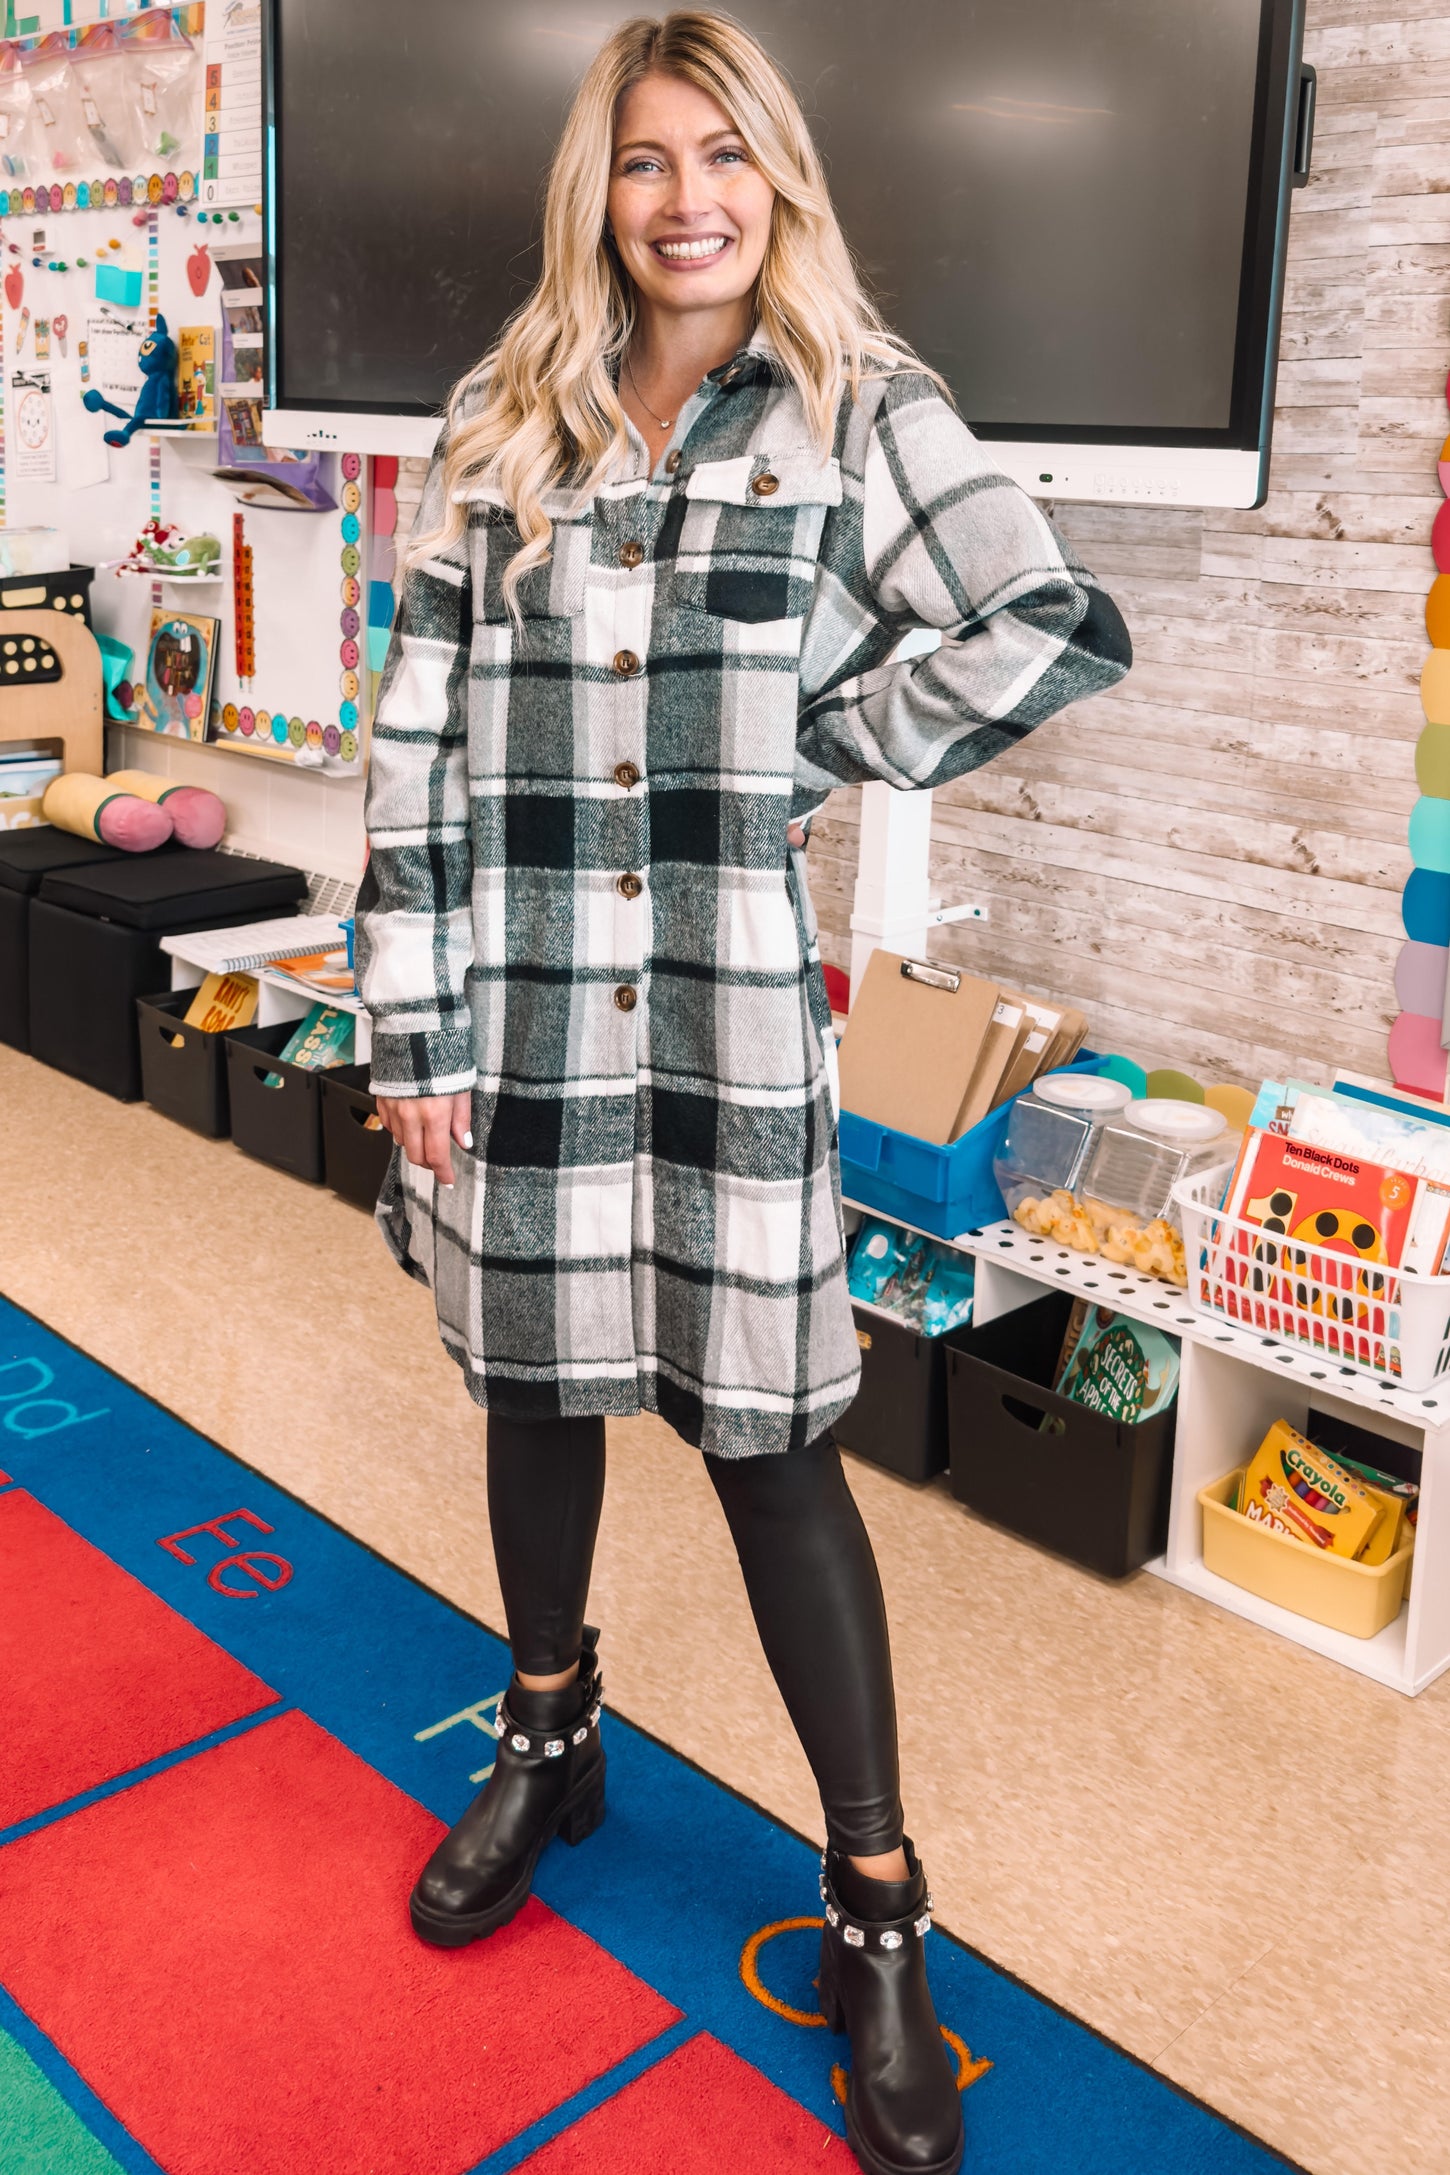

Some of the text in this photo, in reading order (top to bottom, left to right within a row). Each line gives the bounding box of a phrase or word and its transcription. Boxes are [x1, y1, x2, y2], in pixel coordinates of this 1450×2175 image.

[210, 71, 218, 86] 5
[209, 93, 217, 109] 4
[208, 116, 216, 132] 3
[208, 139, 215, 155] 2
[207, 161, 214, 177] 1
[207, 185, 214, 200] 0
[1268, 1121, 1289, 1137] SN
[1285, 1142, 1303, 1157] Ten
[1303, 1146, 1333, 1168] Black
[1333, 1156, 1360, 1174] Dots
[1282, 1154, 1357, 1186] Donald Crews
[1388, 1185, 1401, 1200] 5
[1100, 1343, 1138, 1401] SECRETS
[1099, 1376, 1122, 1413] OF THE
[1286, 1449, 1347, 1506] Crayola
[1245, 1500, 1294, 1536] MAR
[155, 1507, 294, 1599] Ee
